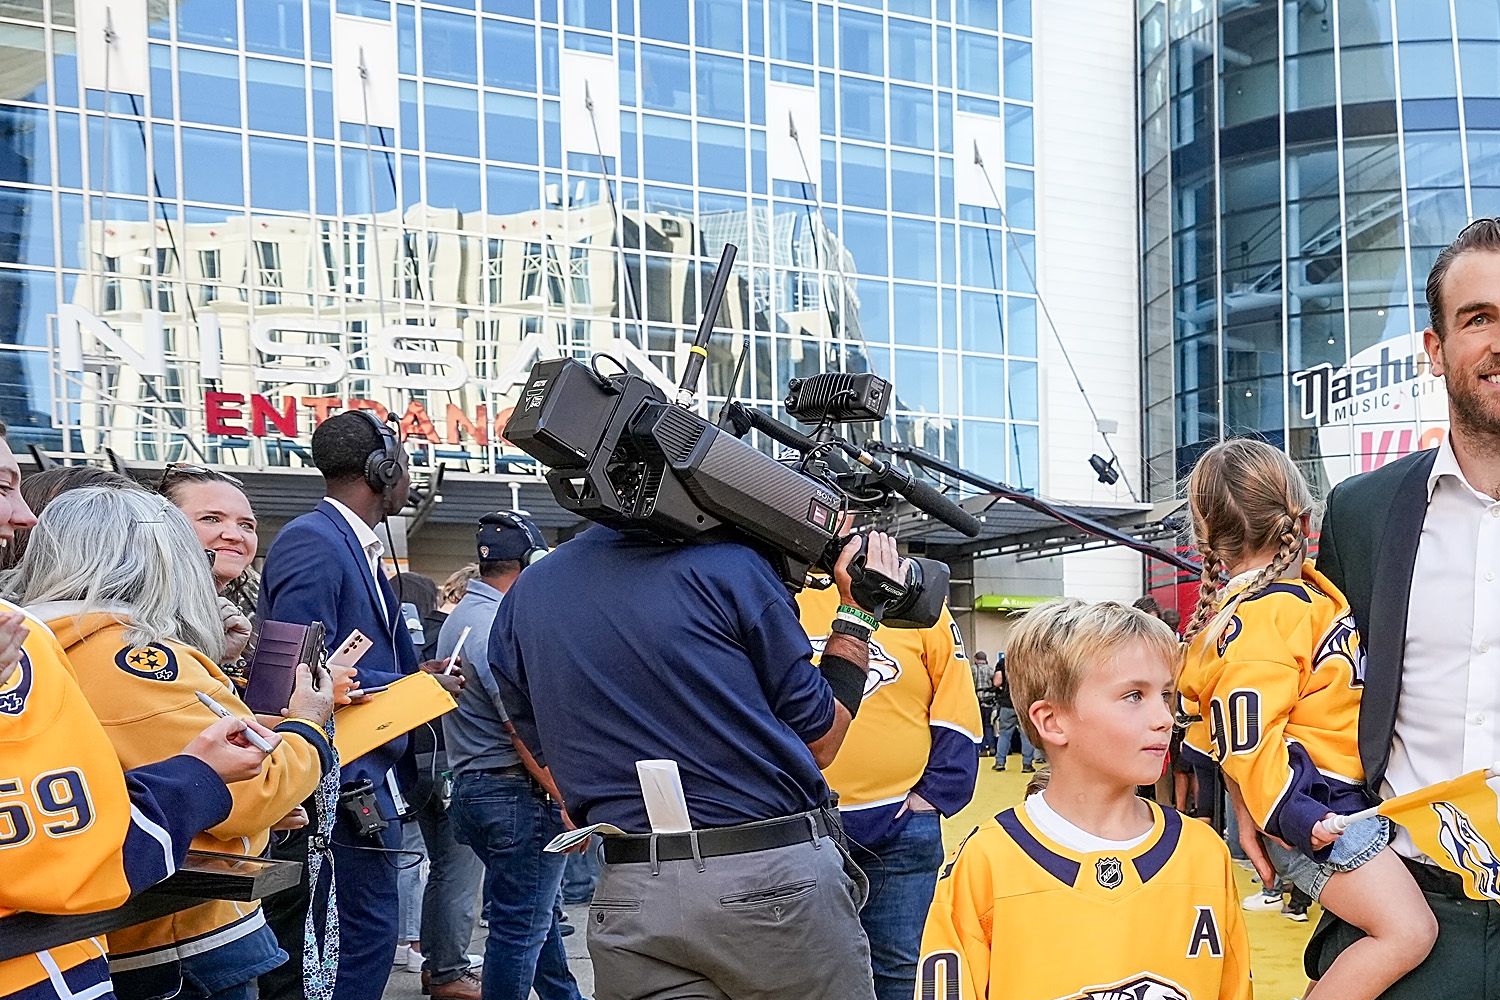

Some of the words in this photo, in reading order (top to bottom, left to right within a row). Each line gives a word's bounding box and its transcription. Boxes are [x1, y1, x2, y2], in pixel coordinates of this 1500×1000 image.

[1297, 346, 1432, 426] Nashv
[1334, 392, 1390, 421] MUSIC
[816, 489, 837, 505] SONY
[0, 766, 96, 850] 59
[1185, 904, 1224, 959] A
